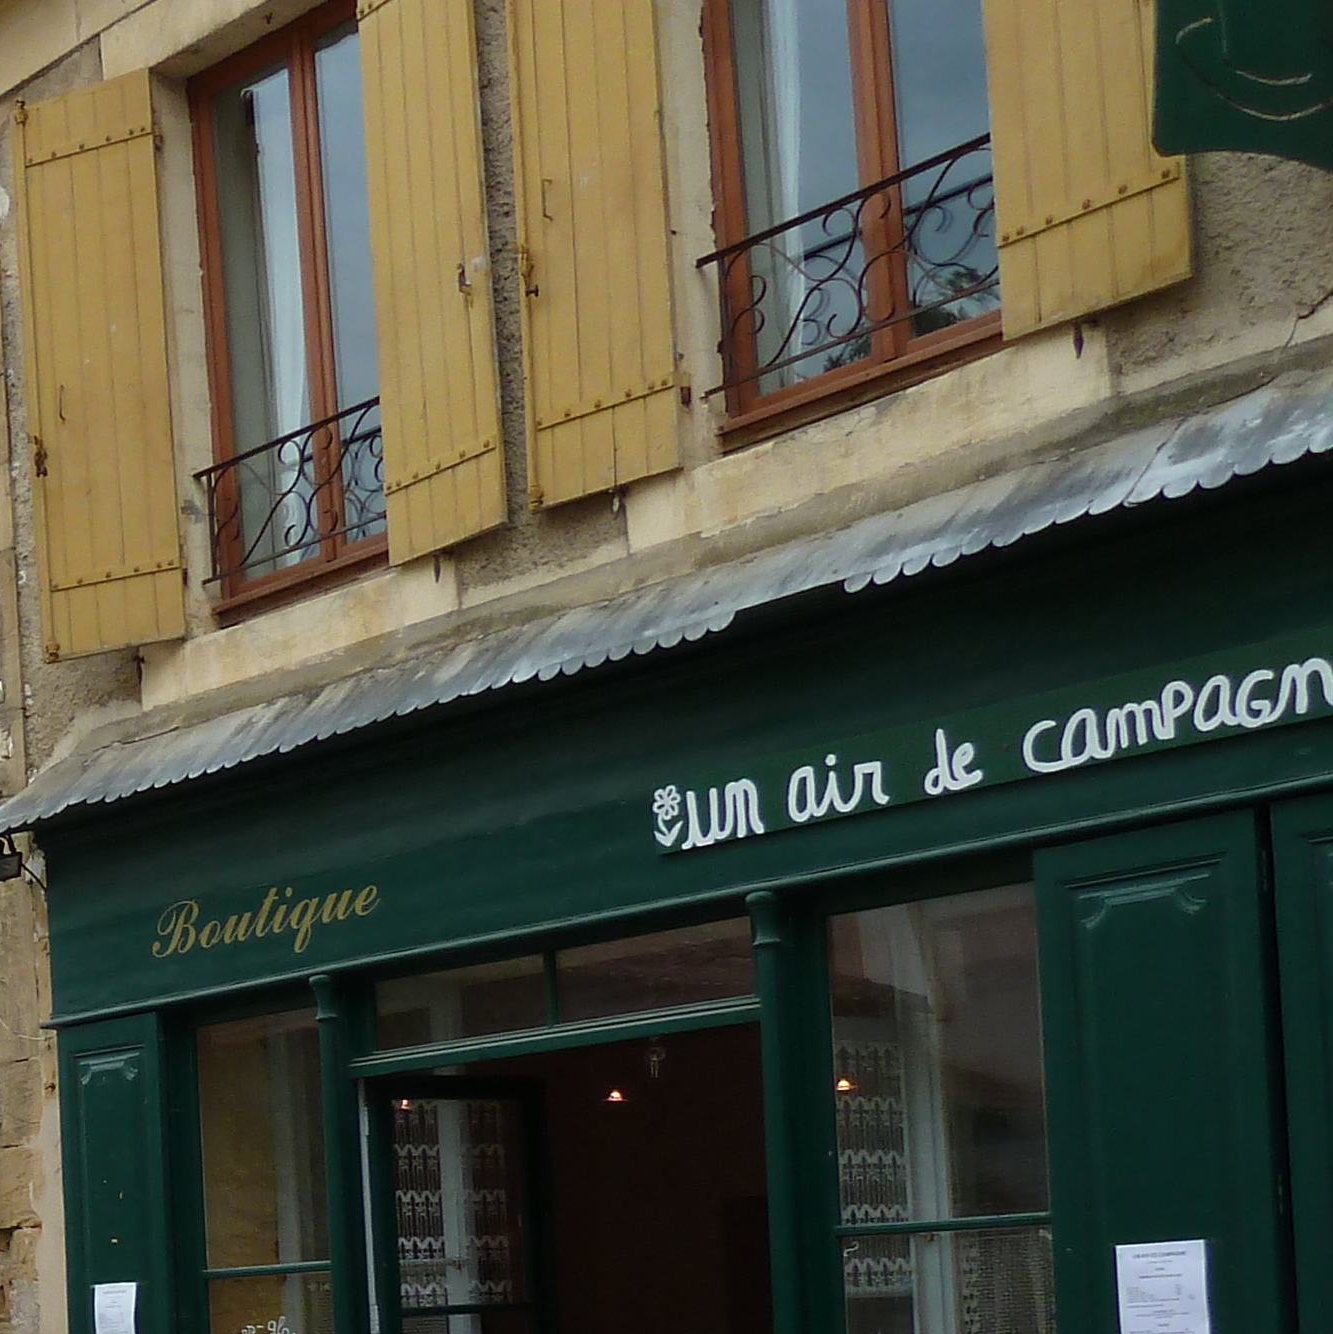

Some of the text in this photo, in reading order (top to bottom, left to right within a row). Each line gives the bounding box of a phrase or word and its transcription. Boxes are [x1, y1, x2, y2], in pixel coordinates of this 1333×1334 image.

[682, 778, 764, 850] un
[788, 753, 890, 823] air
[924, 725, 983, 796] de
[151, 884, 381, 958] Boutique
